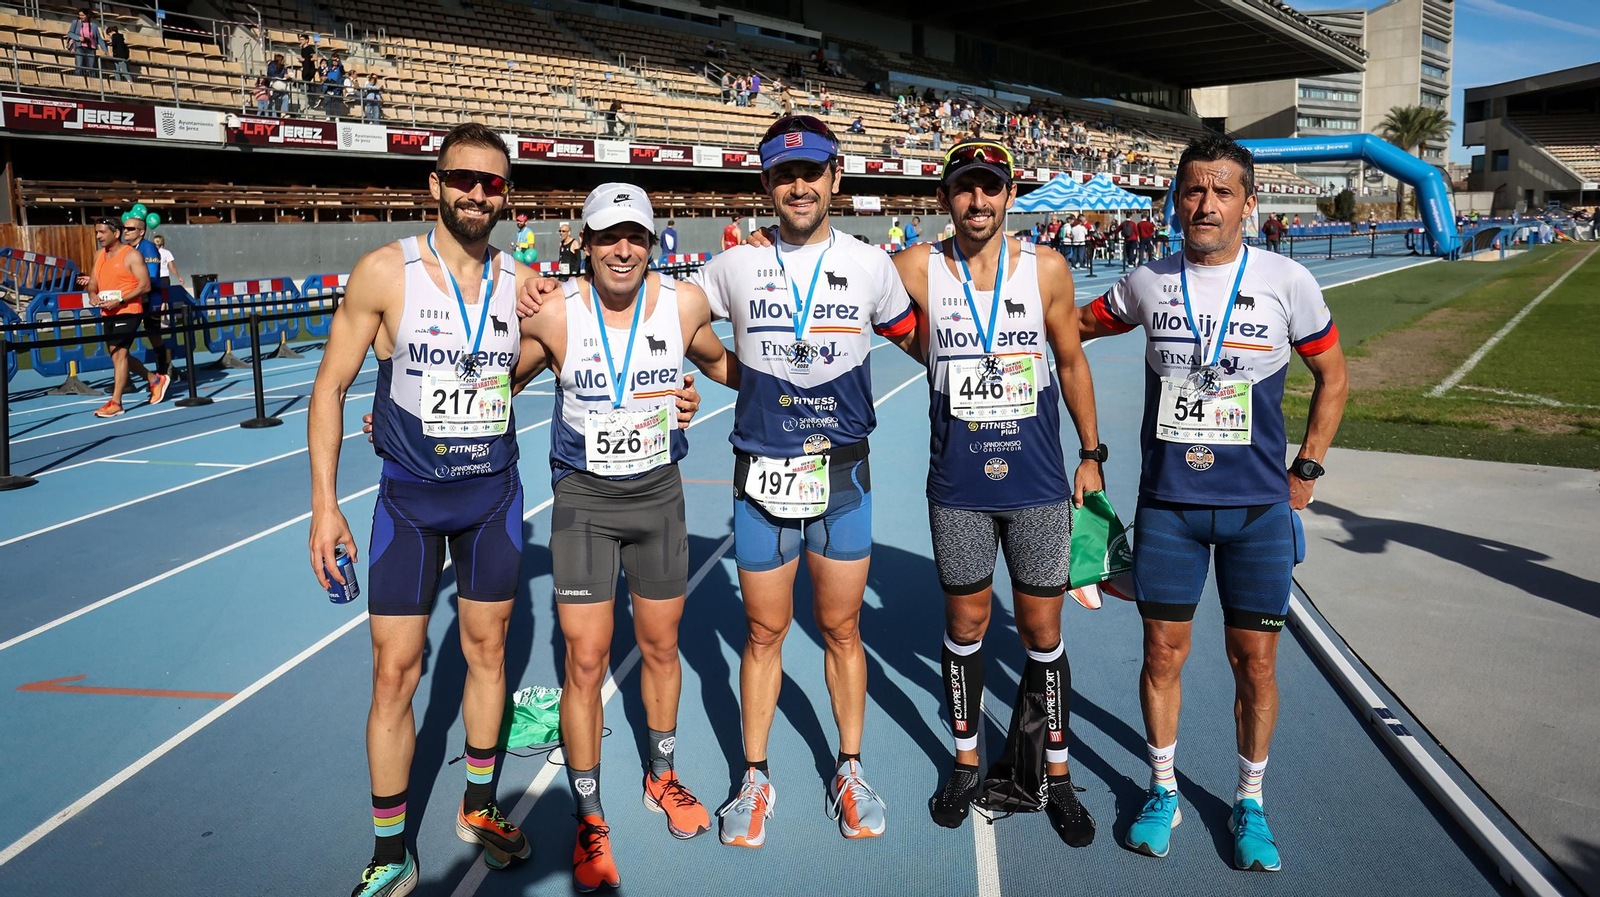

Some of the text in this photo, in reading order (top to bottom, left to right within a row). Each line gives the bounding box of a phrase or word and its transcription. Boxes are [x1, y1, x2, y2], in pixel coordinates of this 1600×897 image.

[14, 103, 71, 120] PLAY
[178, 119, 214, 128] Ayuntamiento
[233, 122, 276, 135] LAY
[392, 134, 426, 145] PLAY
[522, 142, 551, 152] PLAY
[1254, 144, 1313, 153] Ayuntamiento
[1326, 143, 1349, 151] Jerez
[633, 148, 657, 157] PLAY
[724, 154, 745, 162] PLAY
[942, 297, 967, 307] GOBIK
[420, 309, 450, 320] GOBIK
[959, 376, 1004, 400] 446
[431, 389, 478, 415] 217
[793, 396, 835, 406] FITNESS
[1174, 395, 1205, 422] 54
[980, 420, 1017, 430] FITNESS
[596, 430, 641, 455] 526
[983, 440, 1021, 448] SANDIONISIO
[449, 443, 489, 454] FITNESS
[450, 462, 491, 472] SANDIONISIO
[758, 470, 797, 496] 197
[558, 588, 592, 596] LURBEL
